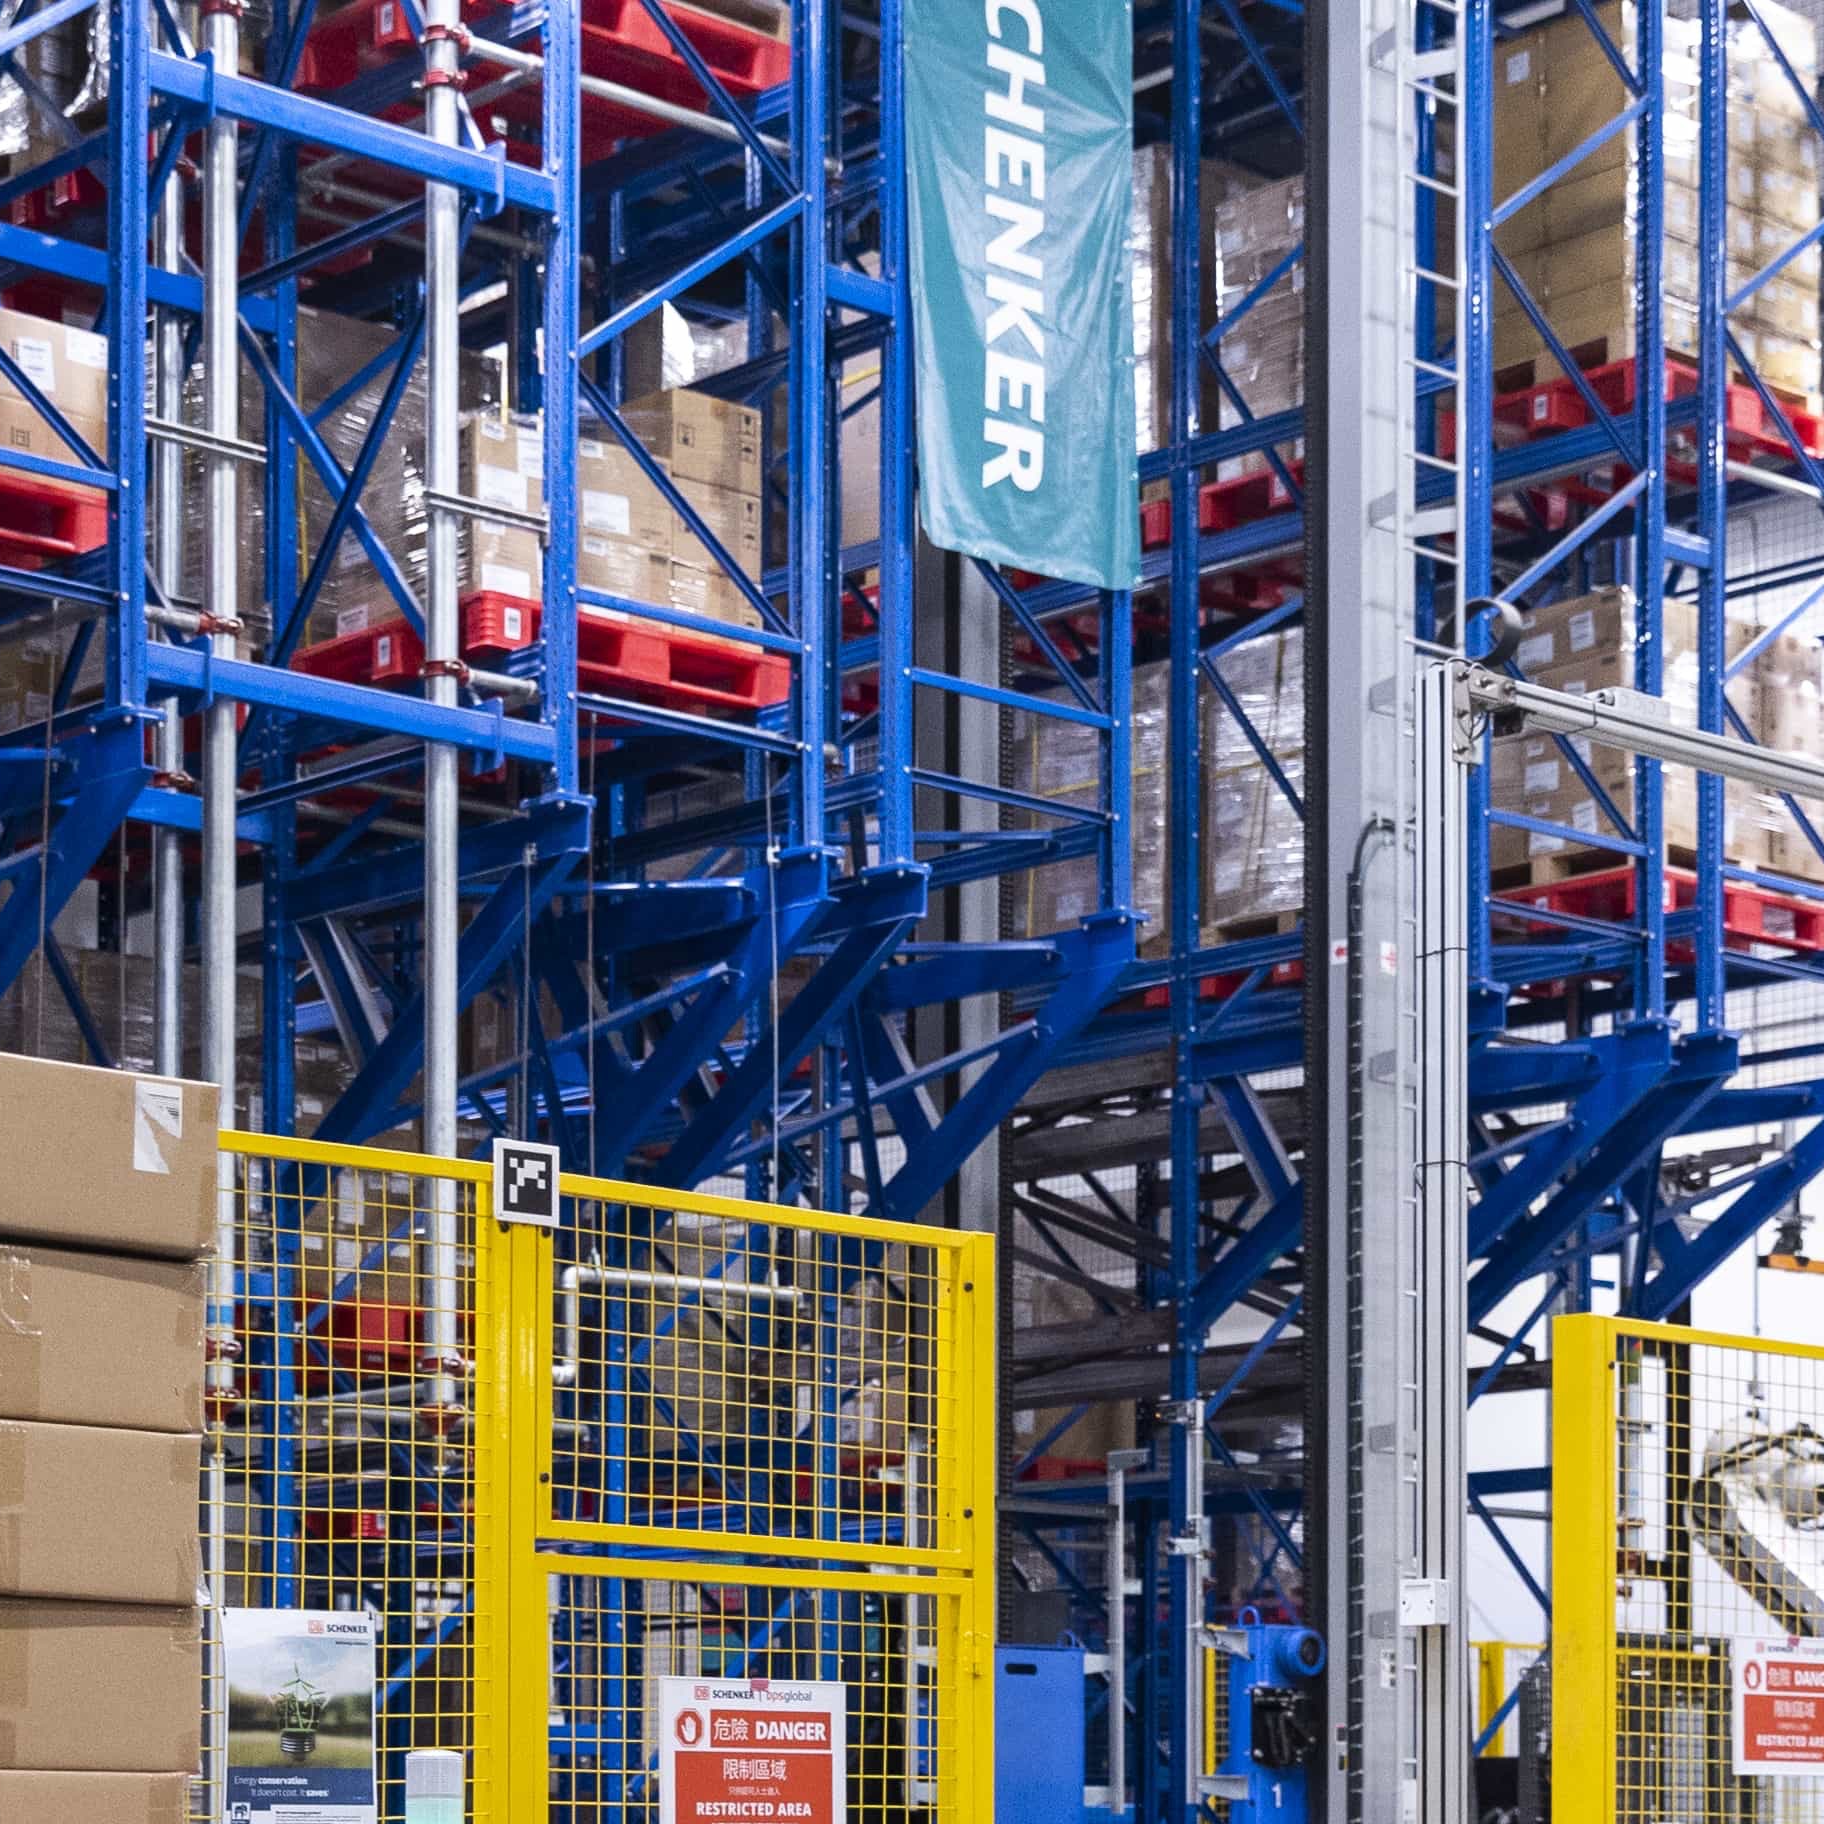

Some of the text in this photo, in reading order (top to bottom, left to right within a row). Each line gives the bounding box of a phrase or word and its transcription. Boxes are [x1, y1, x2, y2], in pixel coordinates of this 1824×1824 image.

[327, 1624, 368, 1634] SCHENKER
[712, 1690, 754, 1700] SCHENKER
[713, 1717, 826, 1742] 危險 DANGER
[722, 1758, 787, 1780] 限制區域
[696, 1801, 812, 1817] RESTRICTED AREA
